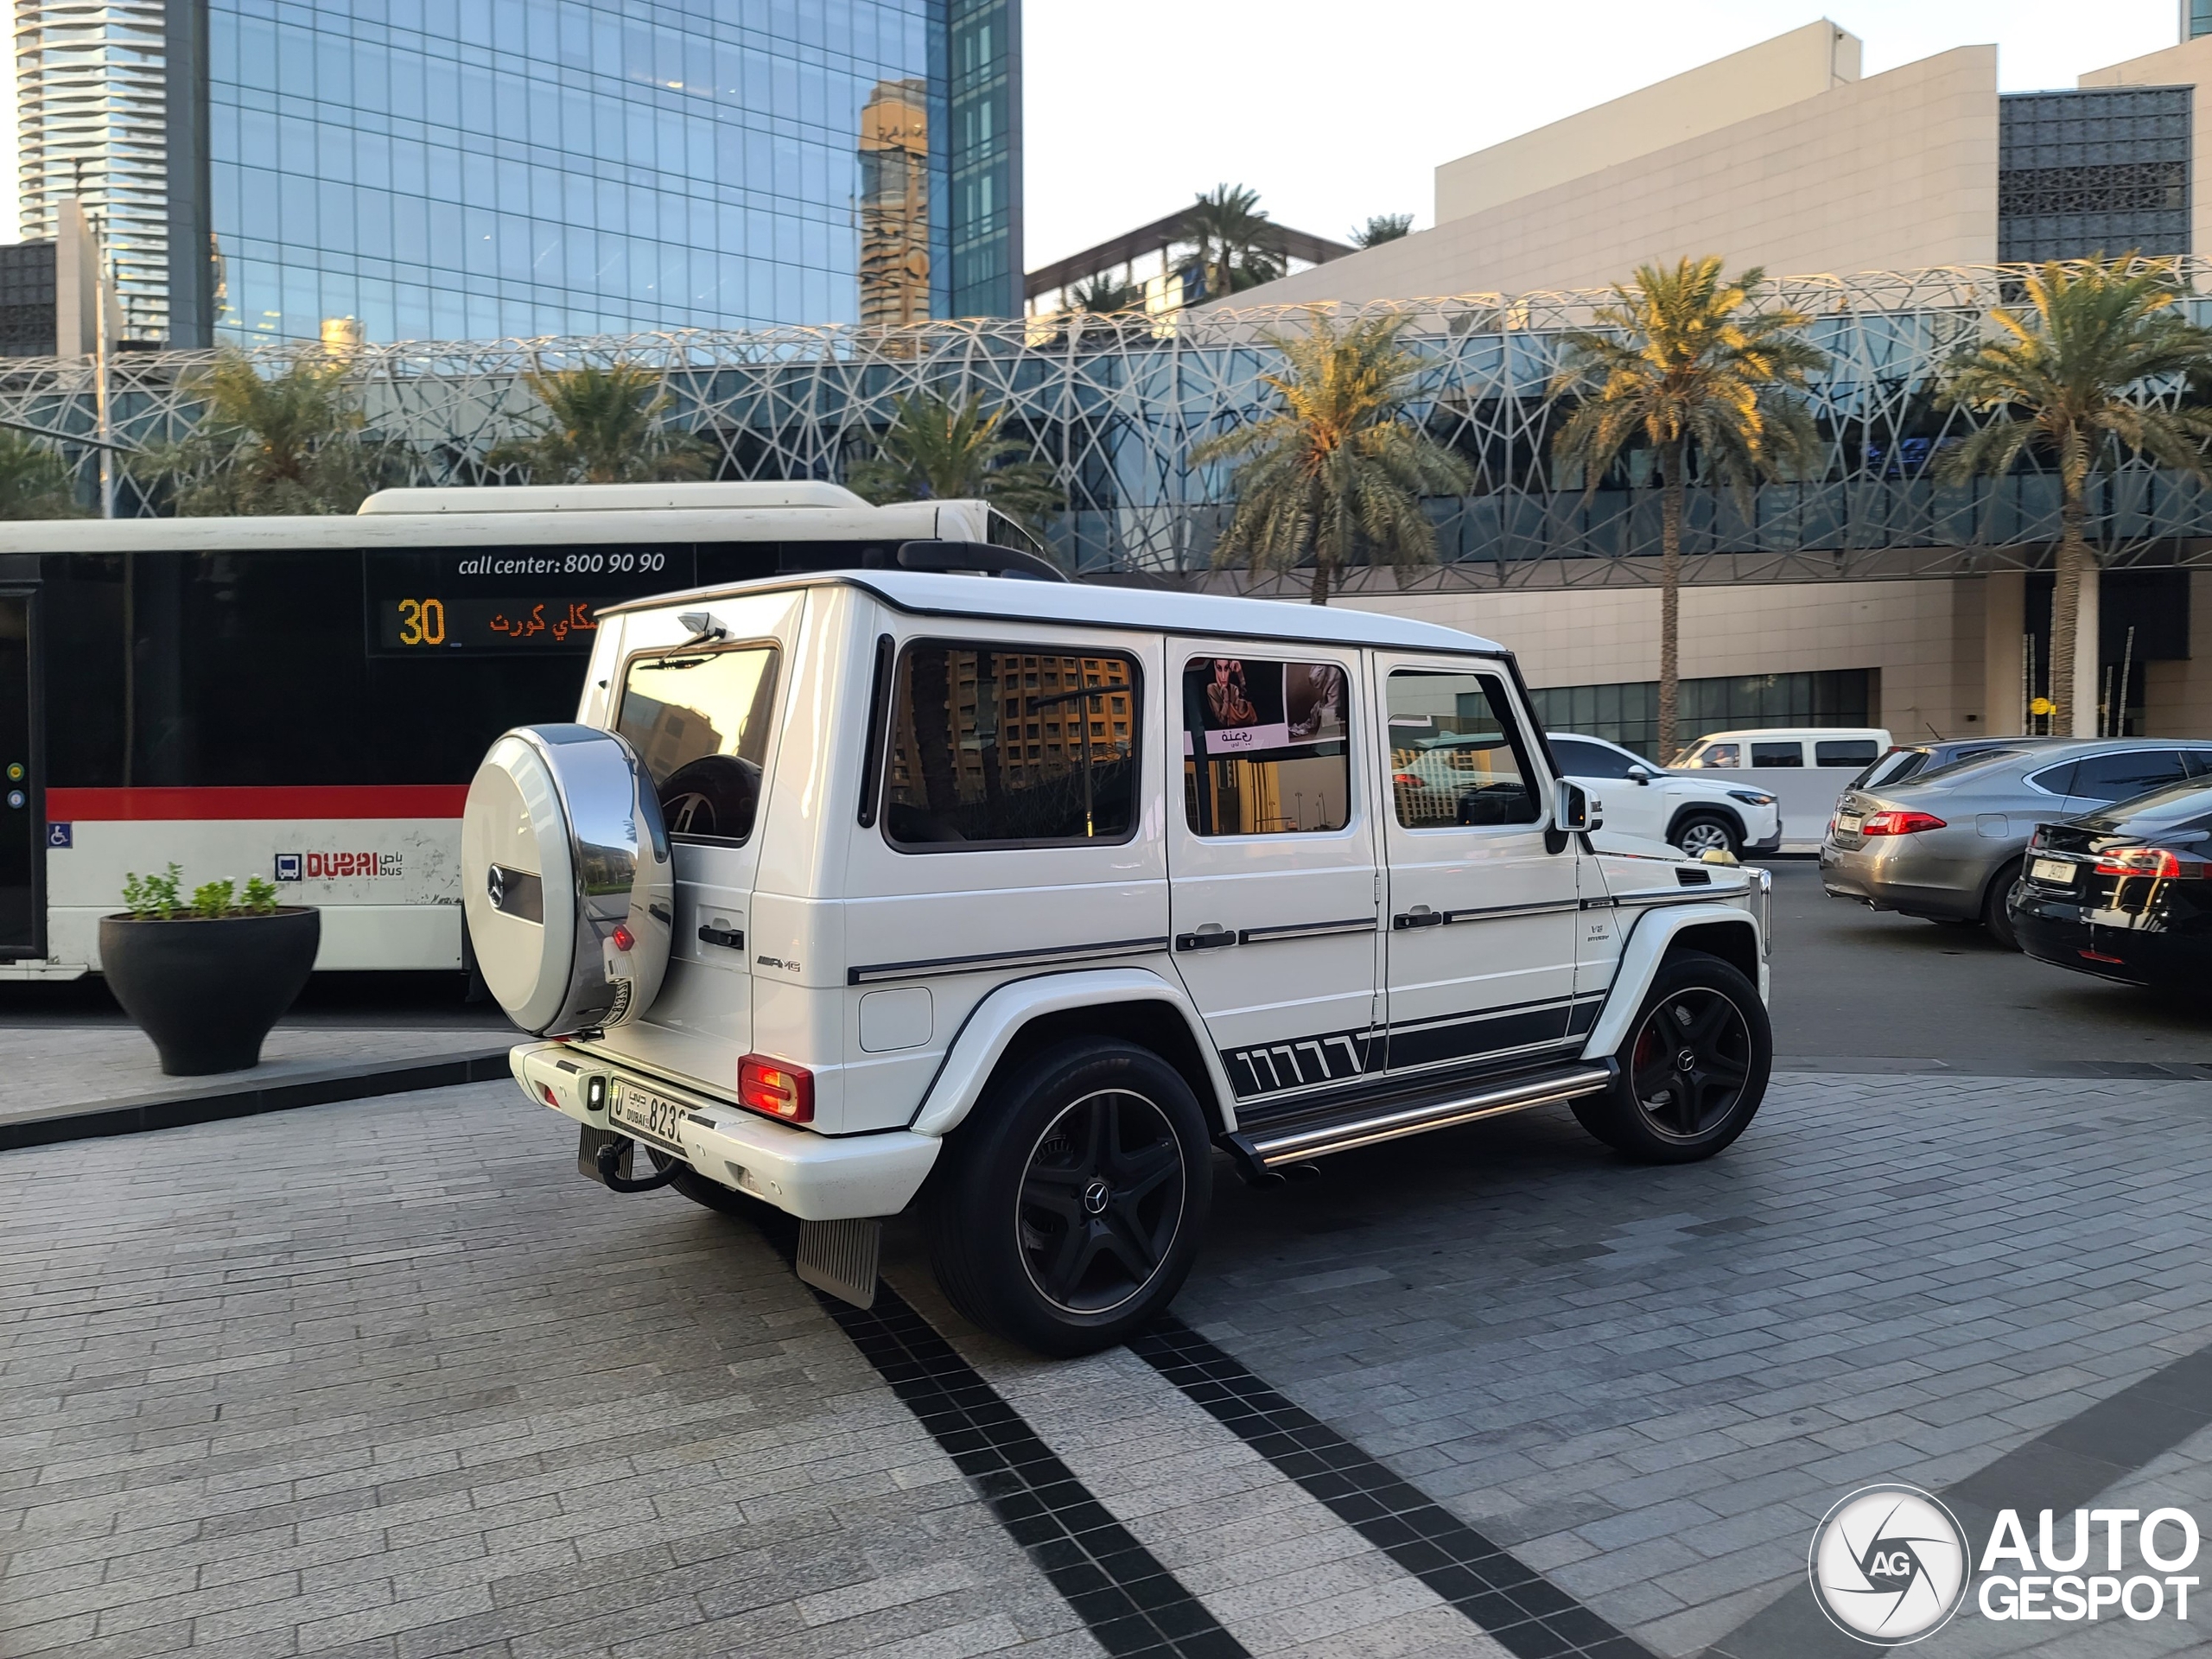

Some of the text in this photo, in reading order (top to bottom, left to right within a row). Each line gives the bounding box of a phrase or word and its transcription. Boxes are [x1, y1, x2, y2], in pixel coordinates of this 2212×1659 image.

[459, 553, 665, 574] call center: 800 90 90
[398, 599, 446, 645] 30
[489, 603, 545, 637] كورت
[308, 852, 378, 878] DUBAI
[379, 851, 403, 865] باص
[379, 866, 402, 876] bus
[629, 1090, 646, 1107] دبي
[626, 1109, 645, 1127] DUBAI
